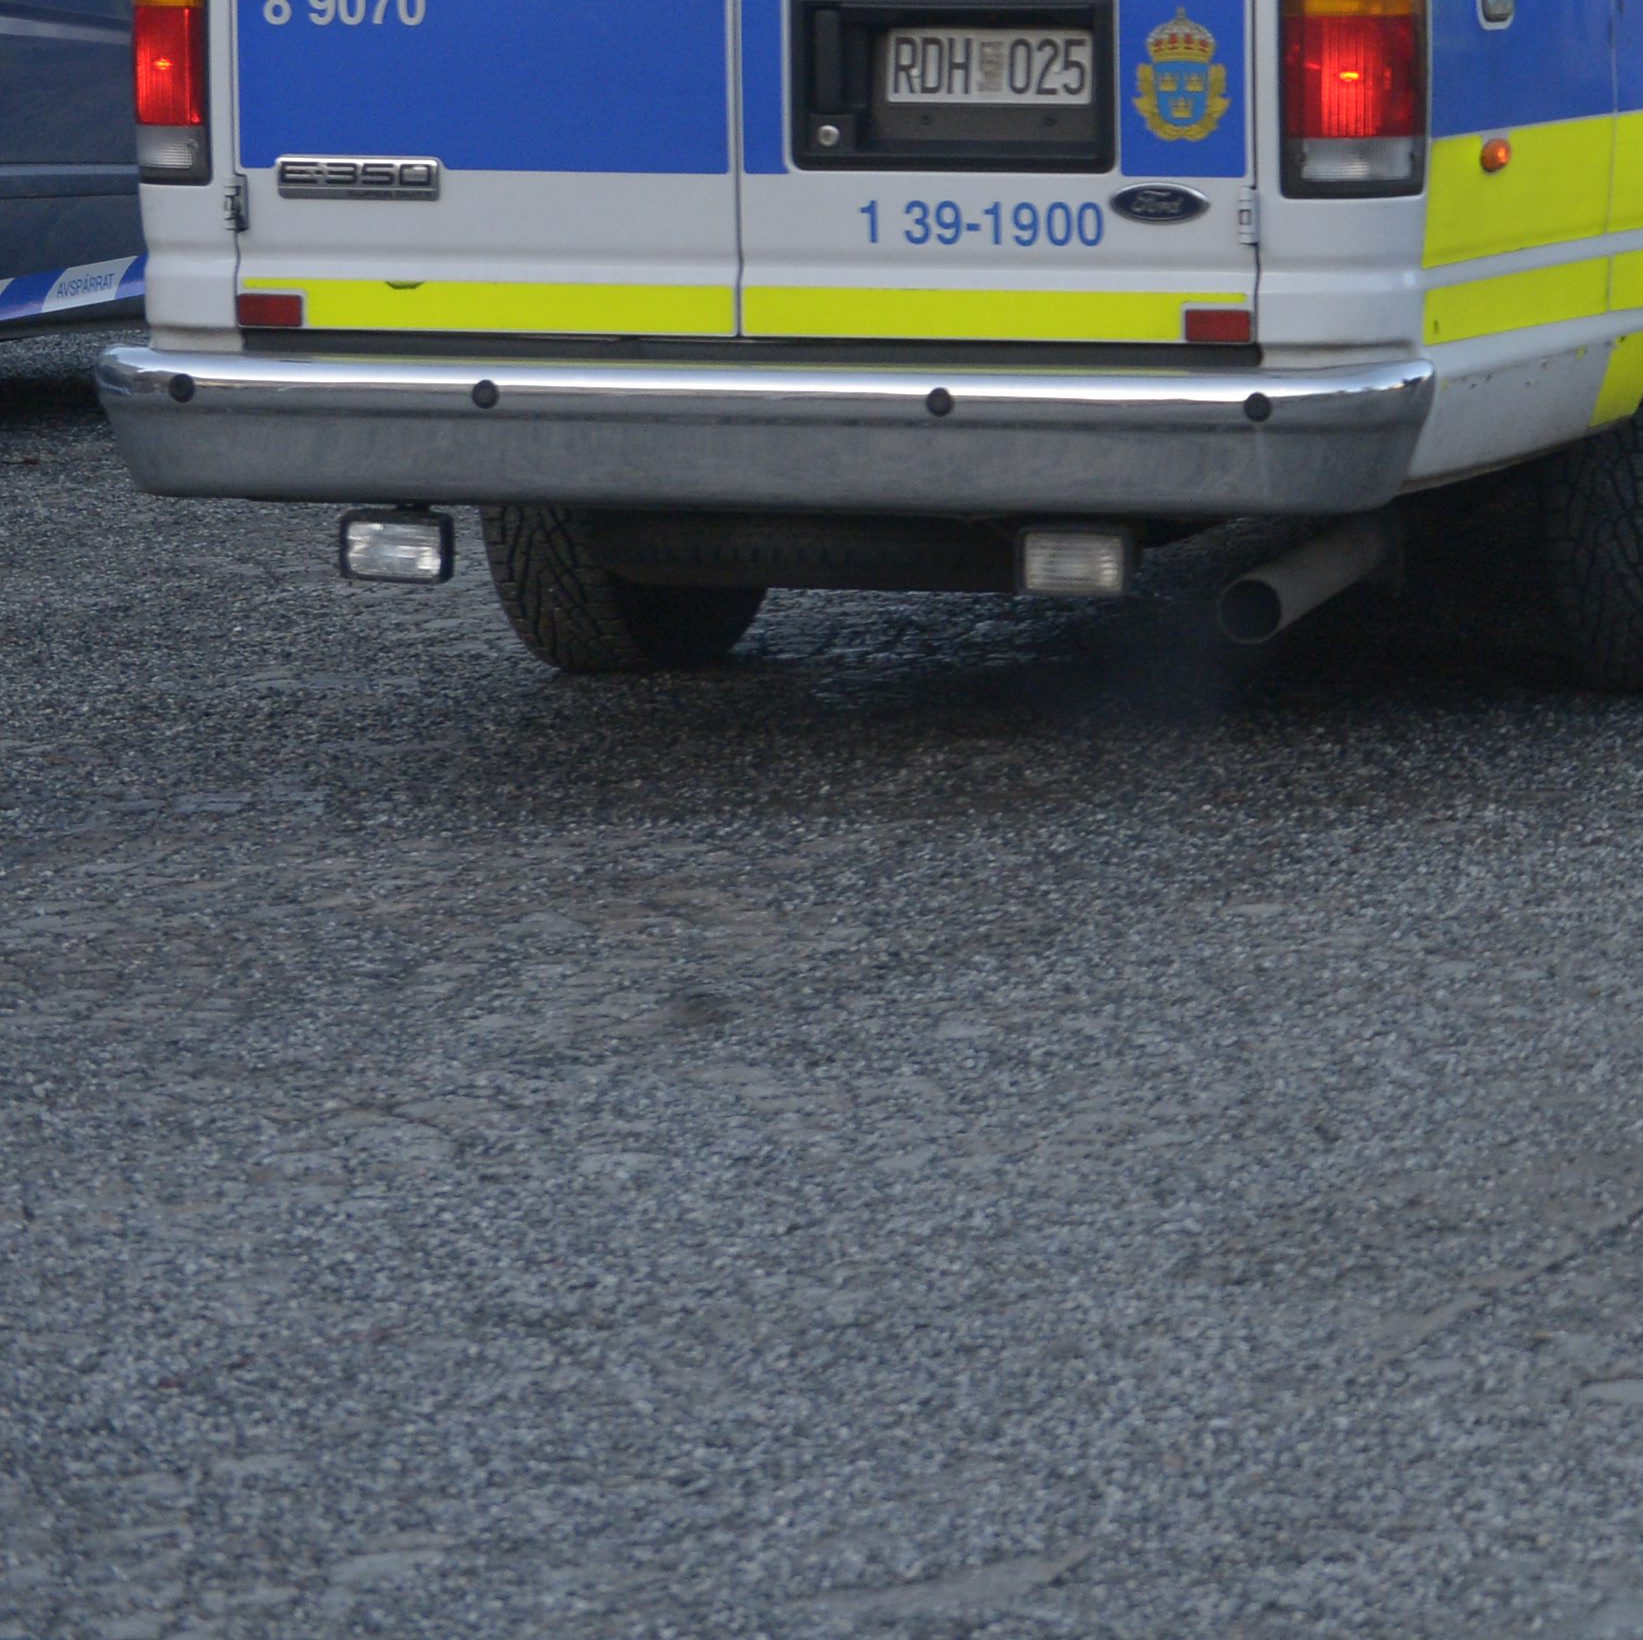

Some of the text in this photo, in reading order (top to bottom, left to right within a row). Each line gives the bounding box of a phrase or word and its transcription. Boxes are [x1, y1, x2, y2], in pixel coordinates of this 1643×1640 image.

[893, 37, 1087, 95] RDH 025
[280, 162, 432, 185] E-350
[860, 200, 1104, 246] 1 39-1900
[57, 273, 114, 298] AVSPÄRRAT
